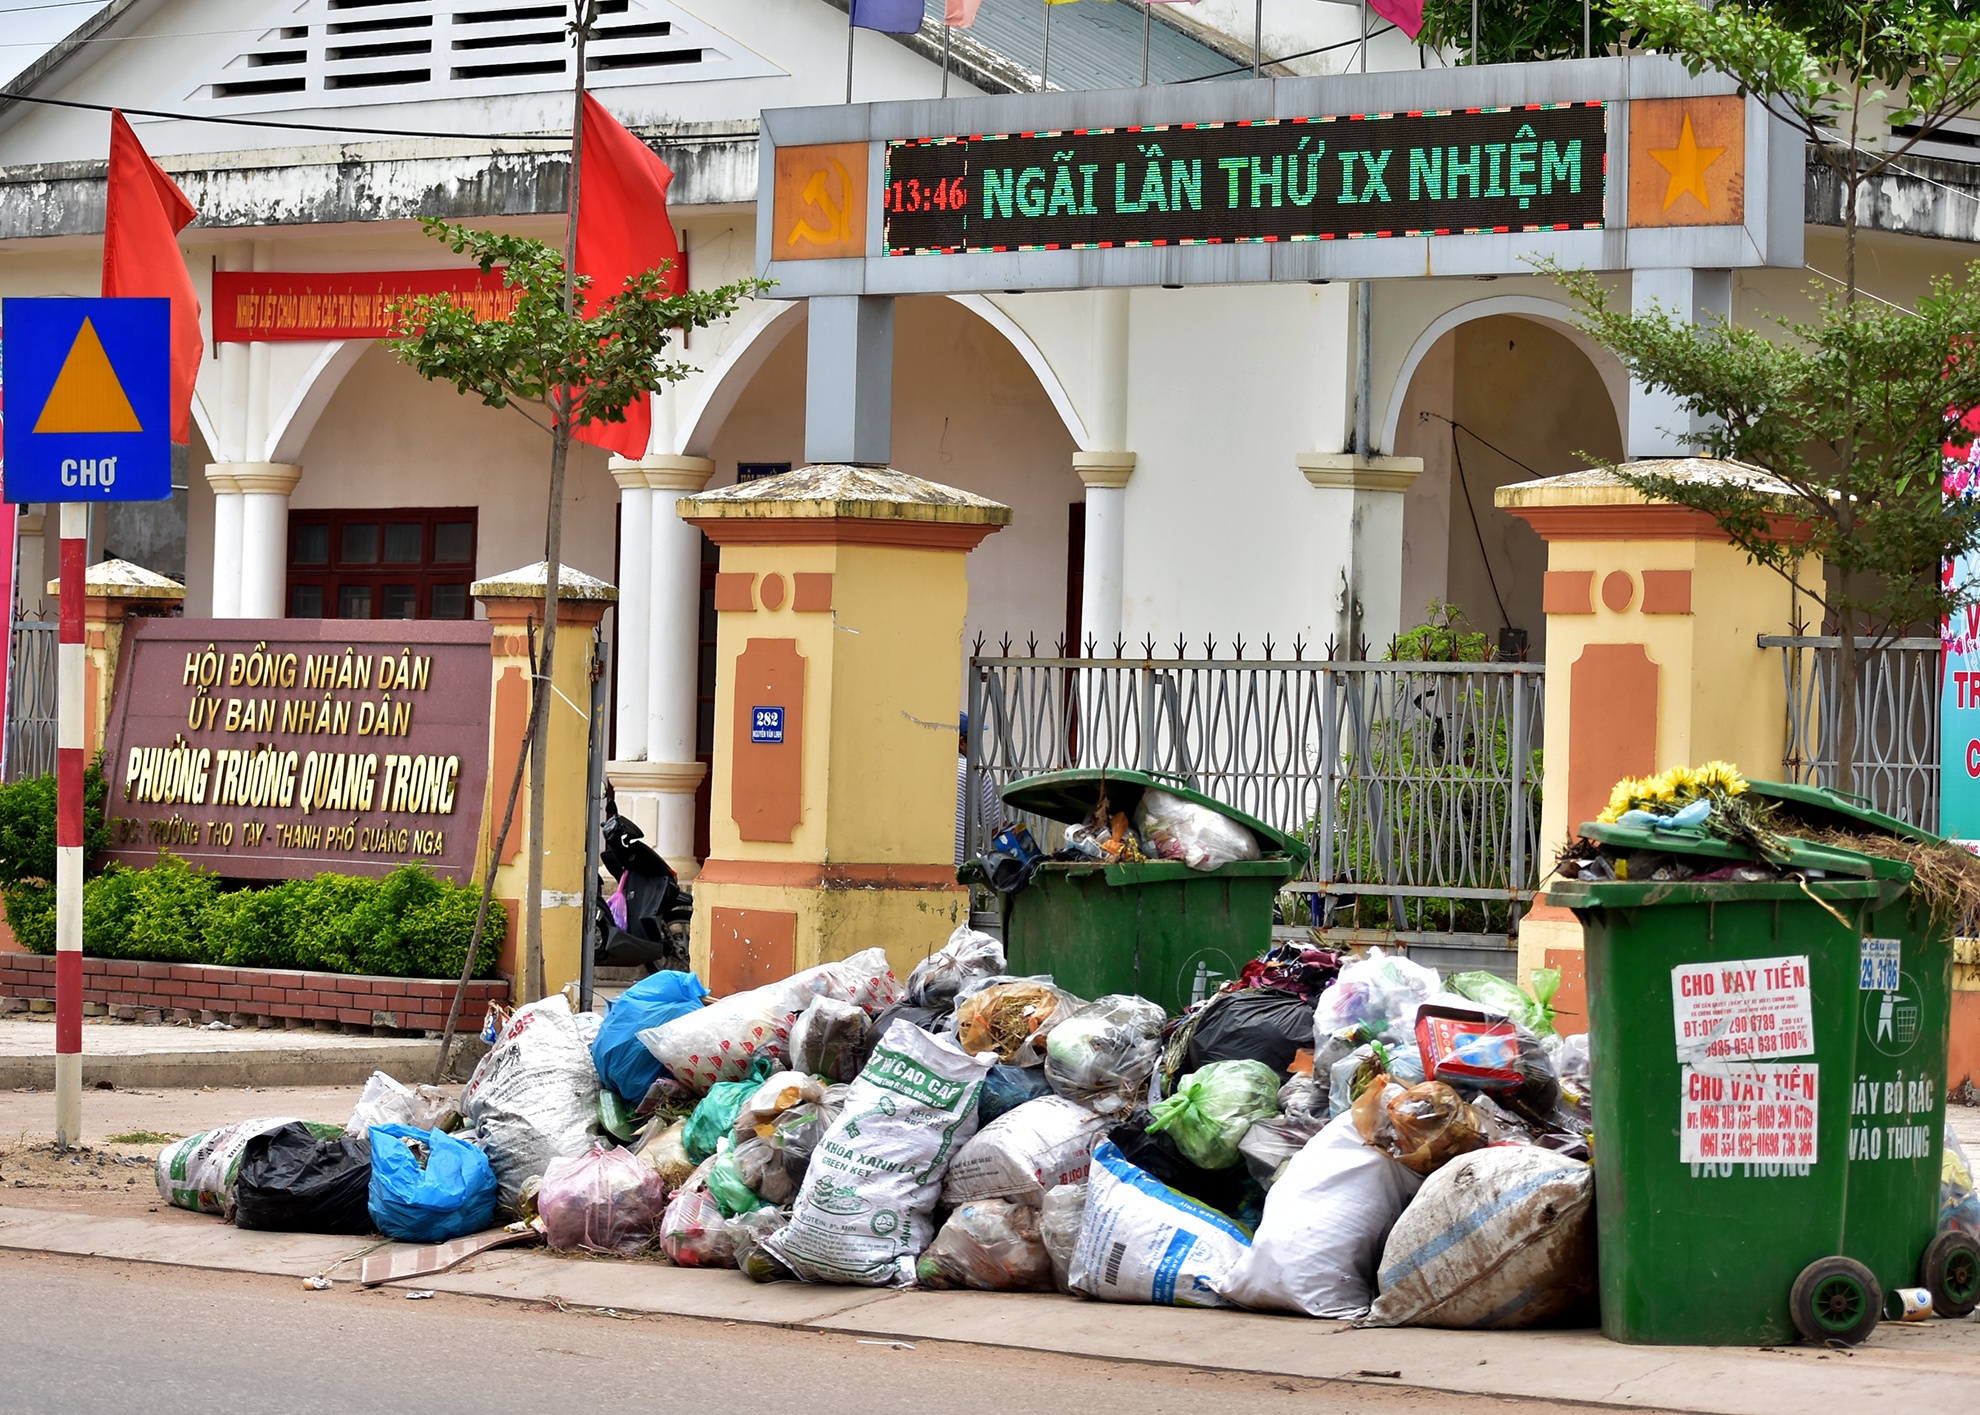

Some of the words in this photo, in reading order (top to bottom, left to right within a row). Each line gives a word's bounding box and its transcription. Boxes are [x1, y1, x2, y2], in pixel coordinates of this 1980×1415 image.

[983, 150, 1099, 219] NGÃI
[1115, 143, 1202, 214] LẦN
[1217, 136, 1326, 209] THỨ
[1337, 149, 1392, 204] IX
[1409, 123, 1582, 210] NHIỆM
[892, 176, 964, 213] 13:46
[61, 456, 118, 493] CHỢ
[229, 641, 298, 688] ĐỒNG
[303, 646, 373, 689] NHÂN
[378, 647, 431, 691] DÂN
[188, 685, 223, 731] ỦY
[225, 698, 277, 732] BAN
[281, 692, 351, 735] NHÂN
[357, 693, 412, 736] DÂN
[757, 712, 779, 726] 282
[124, 733, 211, 805] PHƯỜNG
[300, 750, 378, 815] QUANG
[325, 817, 360, 851] PHỐ
[360, 820, 409, 853] QUẢNG
[1681, 973, 1715, 998] CHO
[1721, 969, 1757, 994] VAY
[1764, 960, 1805, 991] TIỀN
[1750, 1013, 1775, 1032] 6789
[1758, 1034, 1777, 1052] 638
[1778, 1031, 1807, 1050] 100%
[893, 1060, 926, 1086] CAO
[927, 1082, 961, 1100] CẤP
[1773, 1064, 1814, 1101] TIỀN
[1884, 1069, 1904, 1114] BỎ
[1908, 1073, 1934, 1113] RÁC
[1700, 1105, 1719, 1129] 0966
[1722, 1105, 1735, 1129] 913
[1777, 1105, 1792, 1129] 290
[1849, 1120, 1881, 1160] VÀO
[1886, 1118, 1930, 1159] THÙNG
[822, 1156, 848, 1172] GREEN
[849, 1166, 872, 1178] KEY
[857, 1153, 898, 1173] XANH
